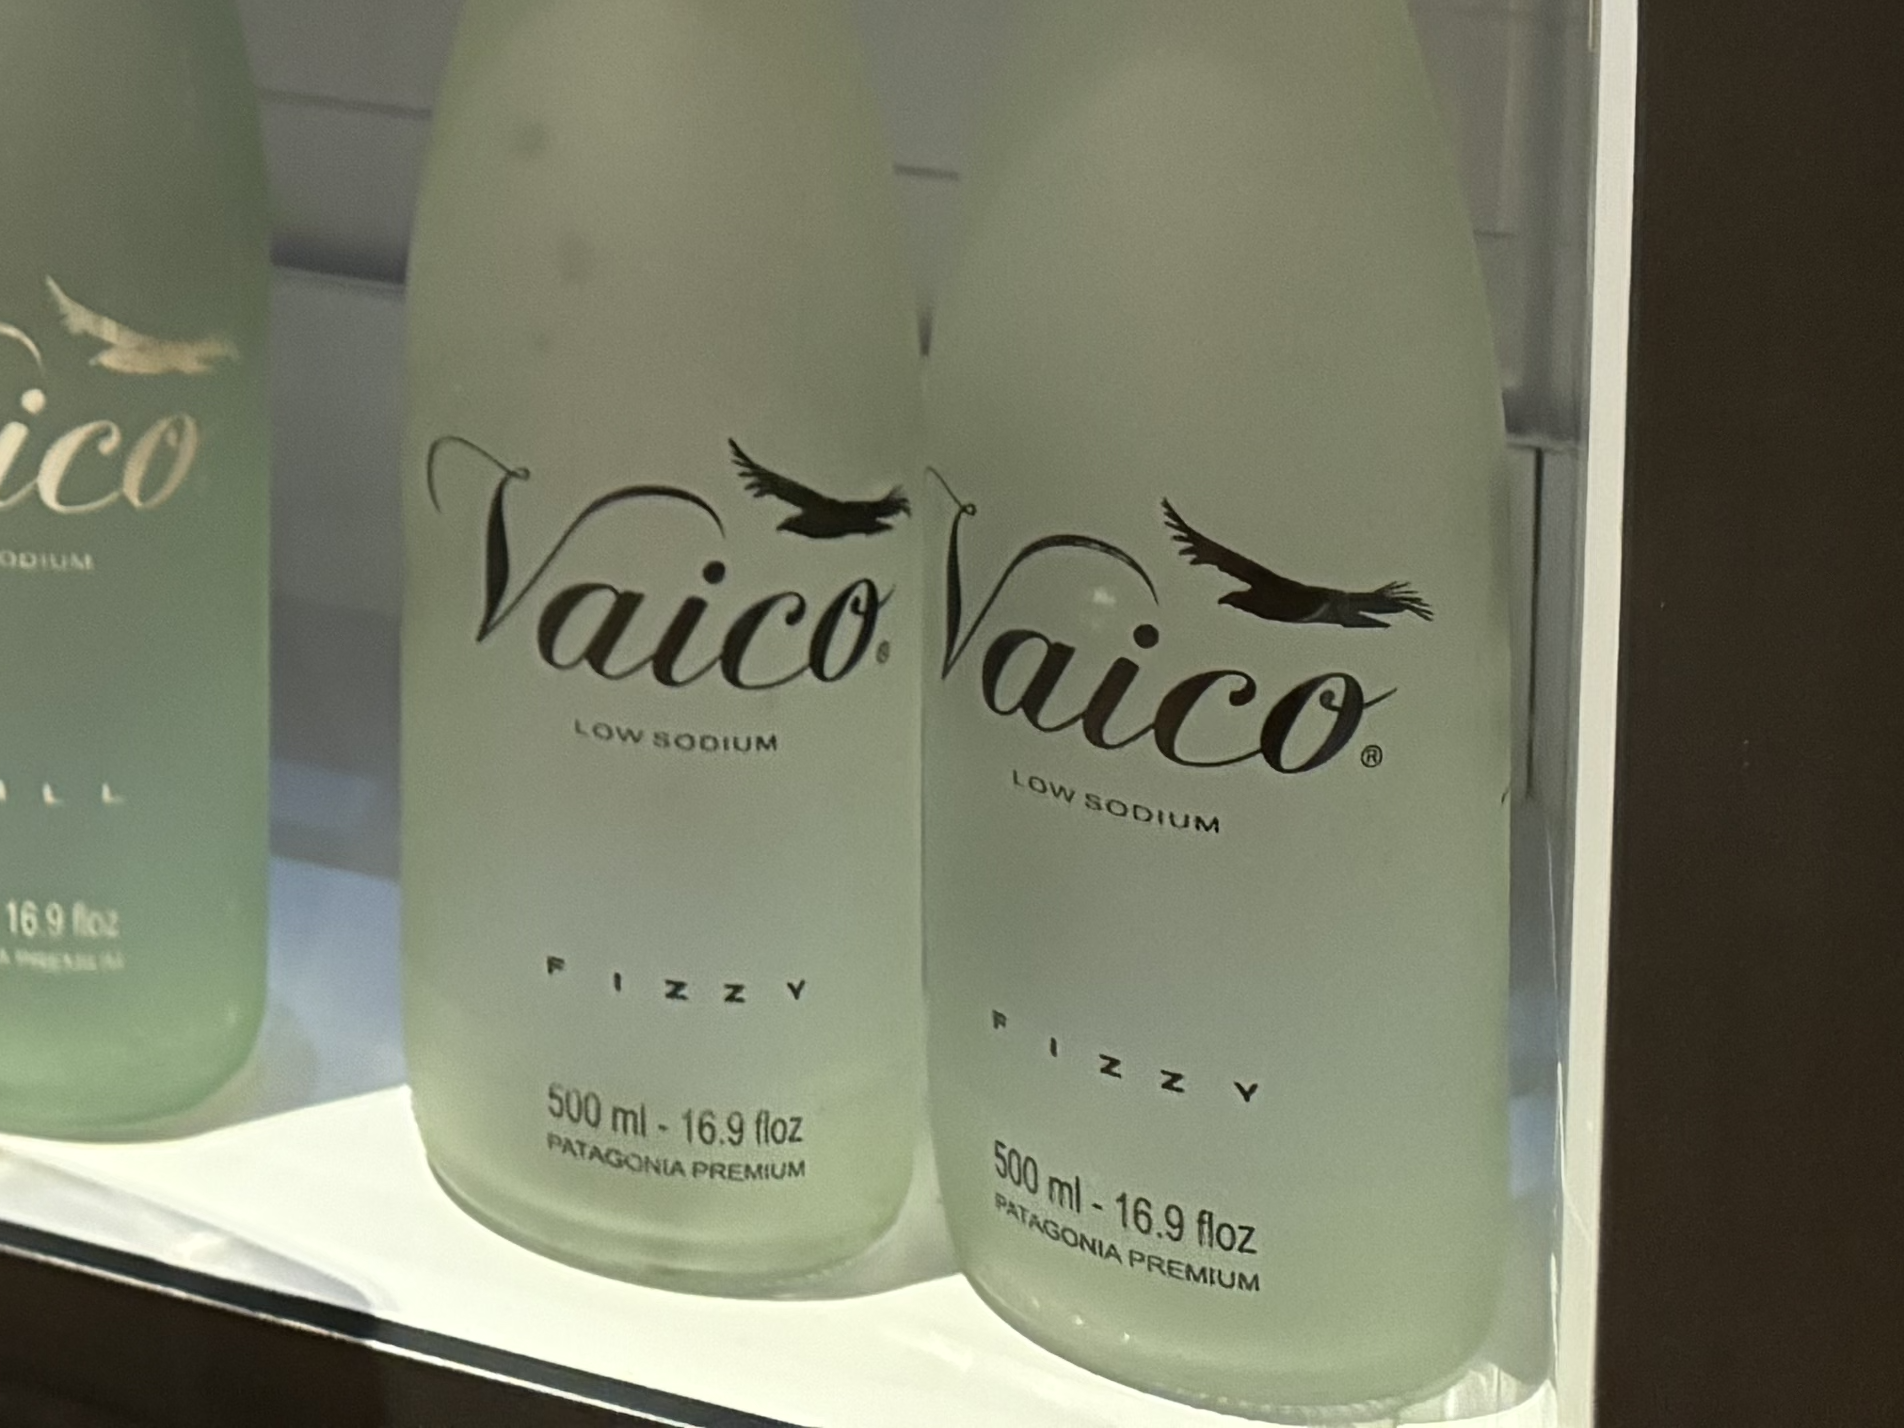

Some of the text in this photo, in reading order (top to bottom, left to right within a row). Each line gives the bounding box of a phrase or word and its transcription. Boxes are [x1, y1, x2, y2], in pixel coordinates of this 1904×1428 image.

[426, 435, 896, 691] Vaico
[926, 466, 1398, 774] Vaico
[574, 719, 779, 753] LOW SODIUM
[1012, 768, 1221, 835] LOW SODIUM
[546, 954, 807, 1004] FIZZY
[992, 1009, 1259, 1104] FIZZY
[548, 1082, 602, 1130] 500
[611, 1102, 648, 1139] ml
[680, 1107, 745, 1147] 16.9
[755, 1108, 804, 1145] floz
[546, 1131, 807, 1183] PATAGONIA PREMIUM
[994, 1139, 1039, 1196] 500
[1047, 1175, 1081, 1214] ml
[1115, 1192, 1185, 1243] 16.9
[1196, 1209, 1258, 1255] floz
[994, 1193, 1261, 1293] PATAGONIA PREMIUM
